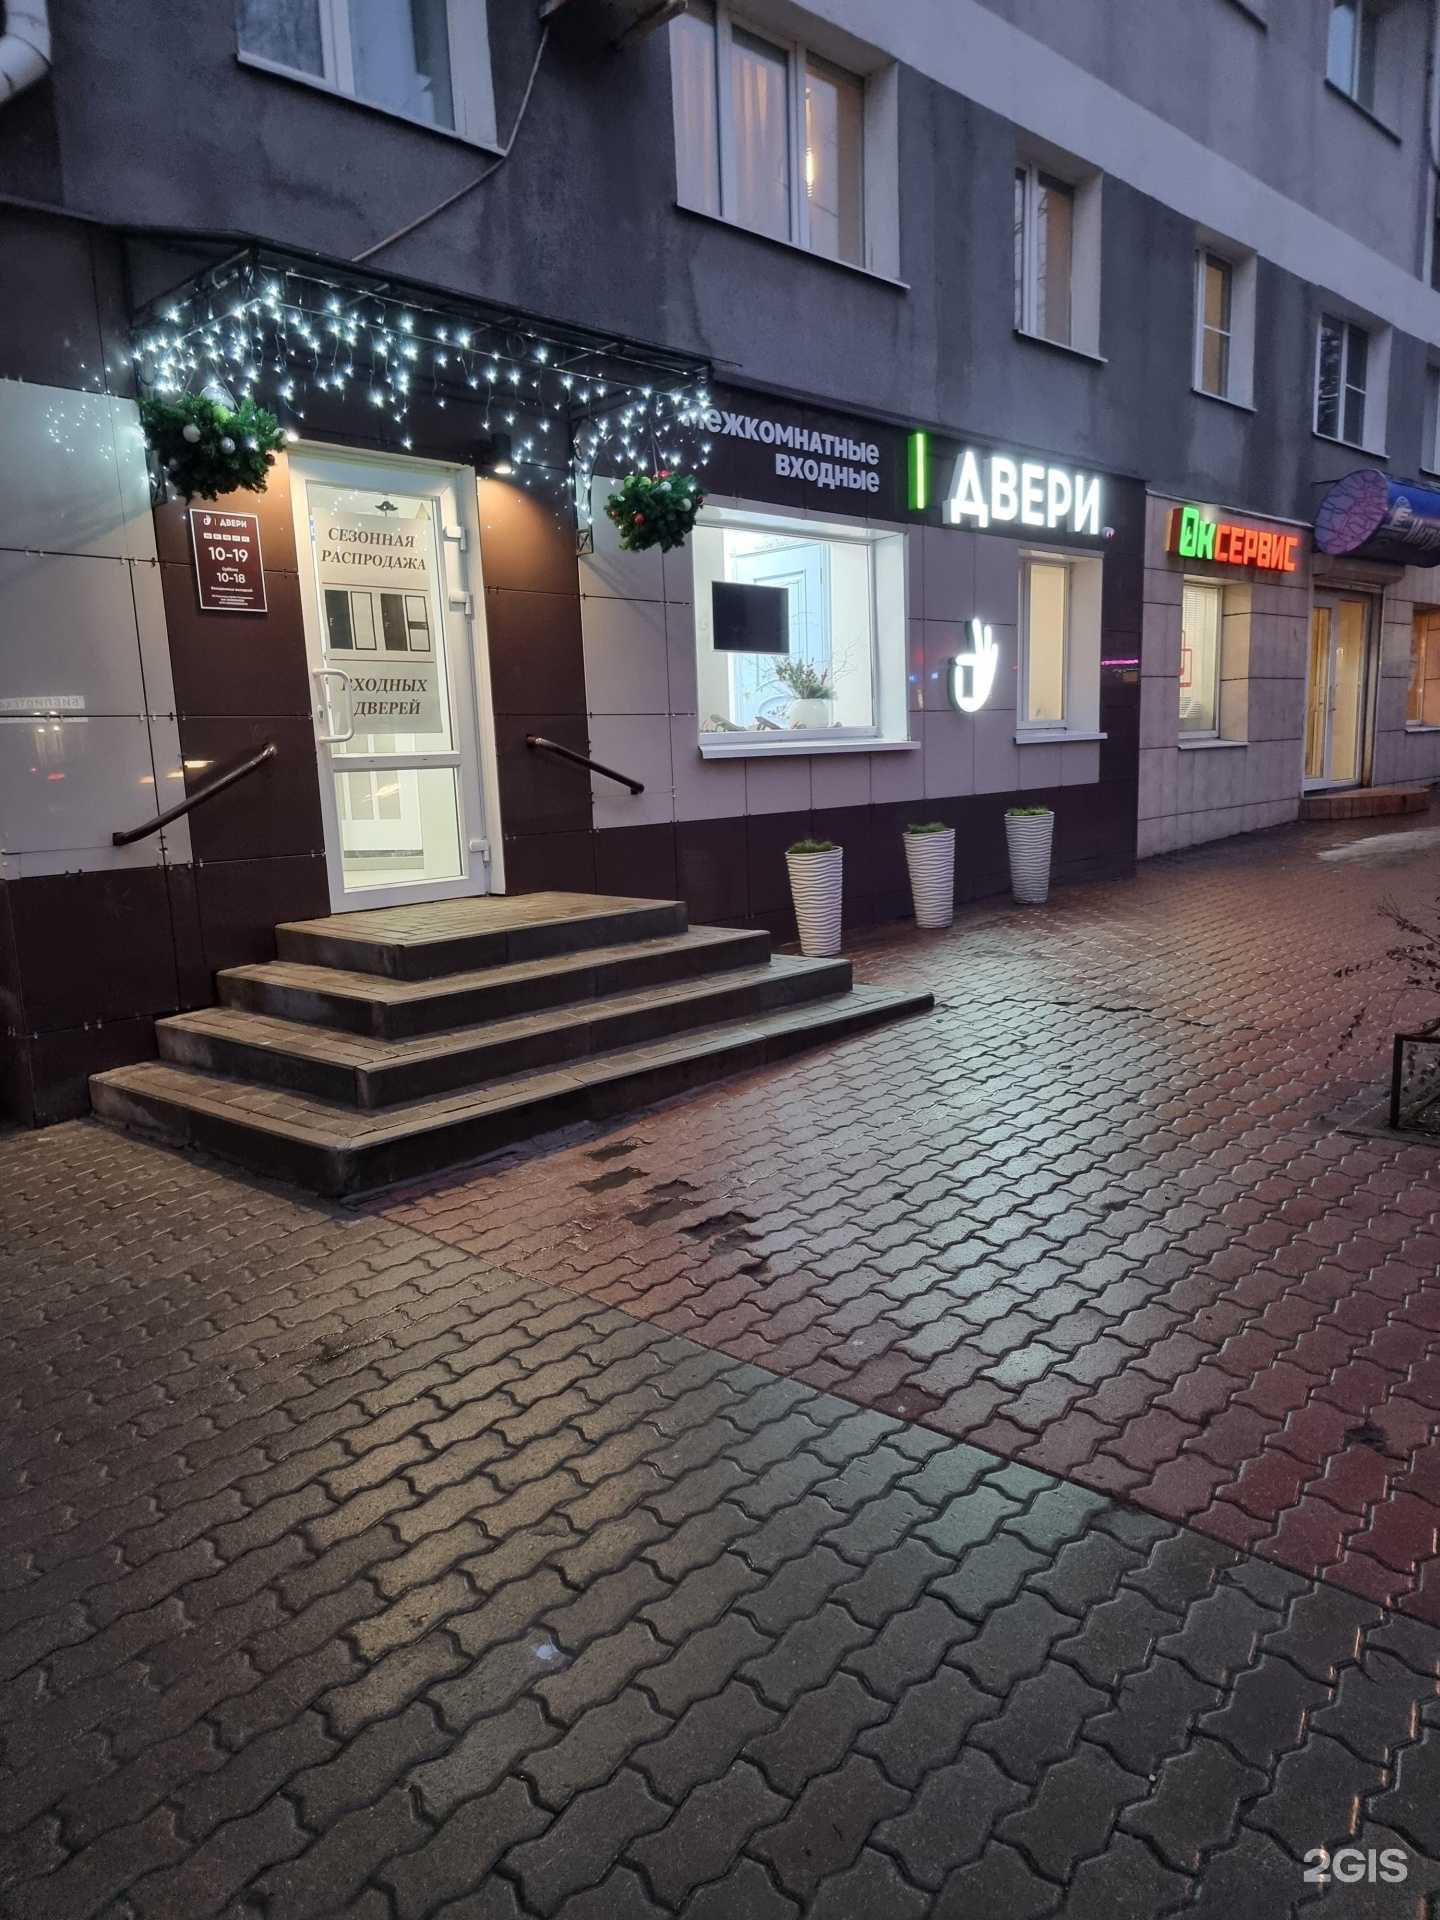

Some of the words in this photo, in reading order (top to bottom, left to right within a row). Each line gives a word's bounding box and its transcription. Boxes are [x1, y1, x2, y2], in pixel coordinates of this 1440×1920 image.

[775, 453, 880, 493] входные
[945, 450, 1099, 535] ДВЕРИ
[220, 518, 248, 528] ДВЕРИ
[328, 527, 416, 549] СЕЗОННАЯ
[208, 546, 249, 562] 10-19
[321, 550, 427, 571] РАСПРОДАЖА
[216, 572, 246, 584] 10-18
[341, 678, 428, 694] ХОДНЫХ
[353, 698, 421, 717] ДВЕРЕЙ
